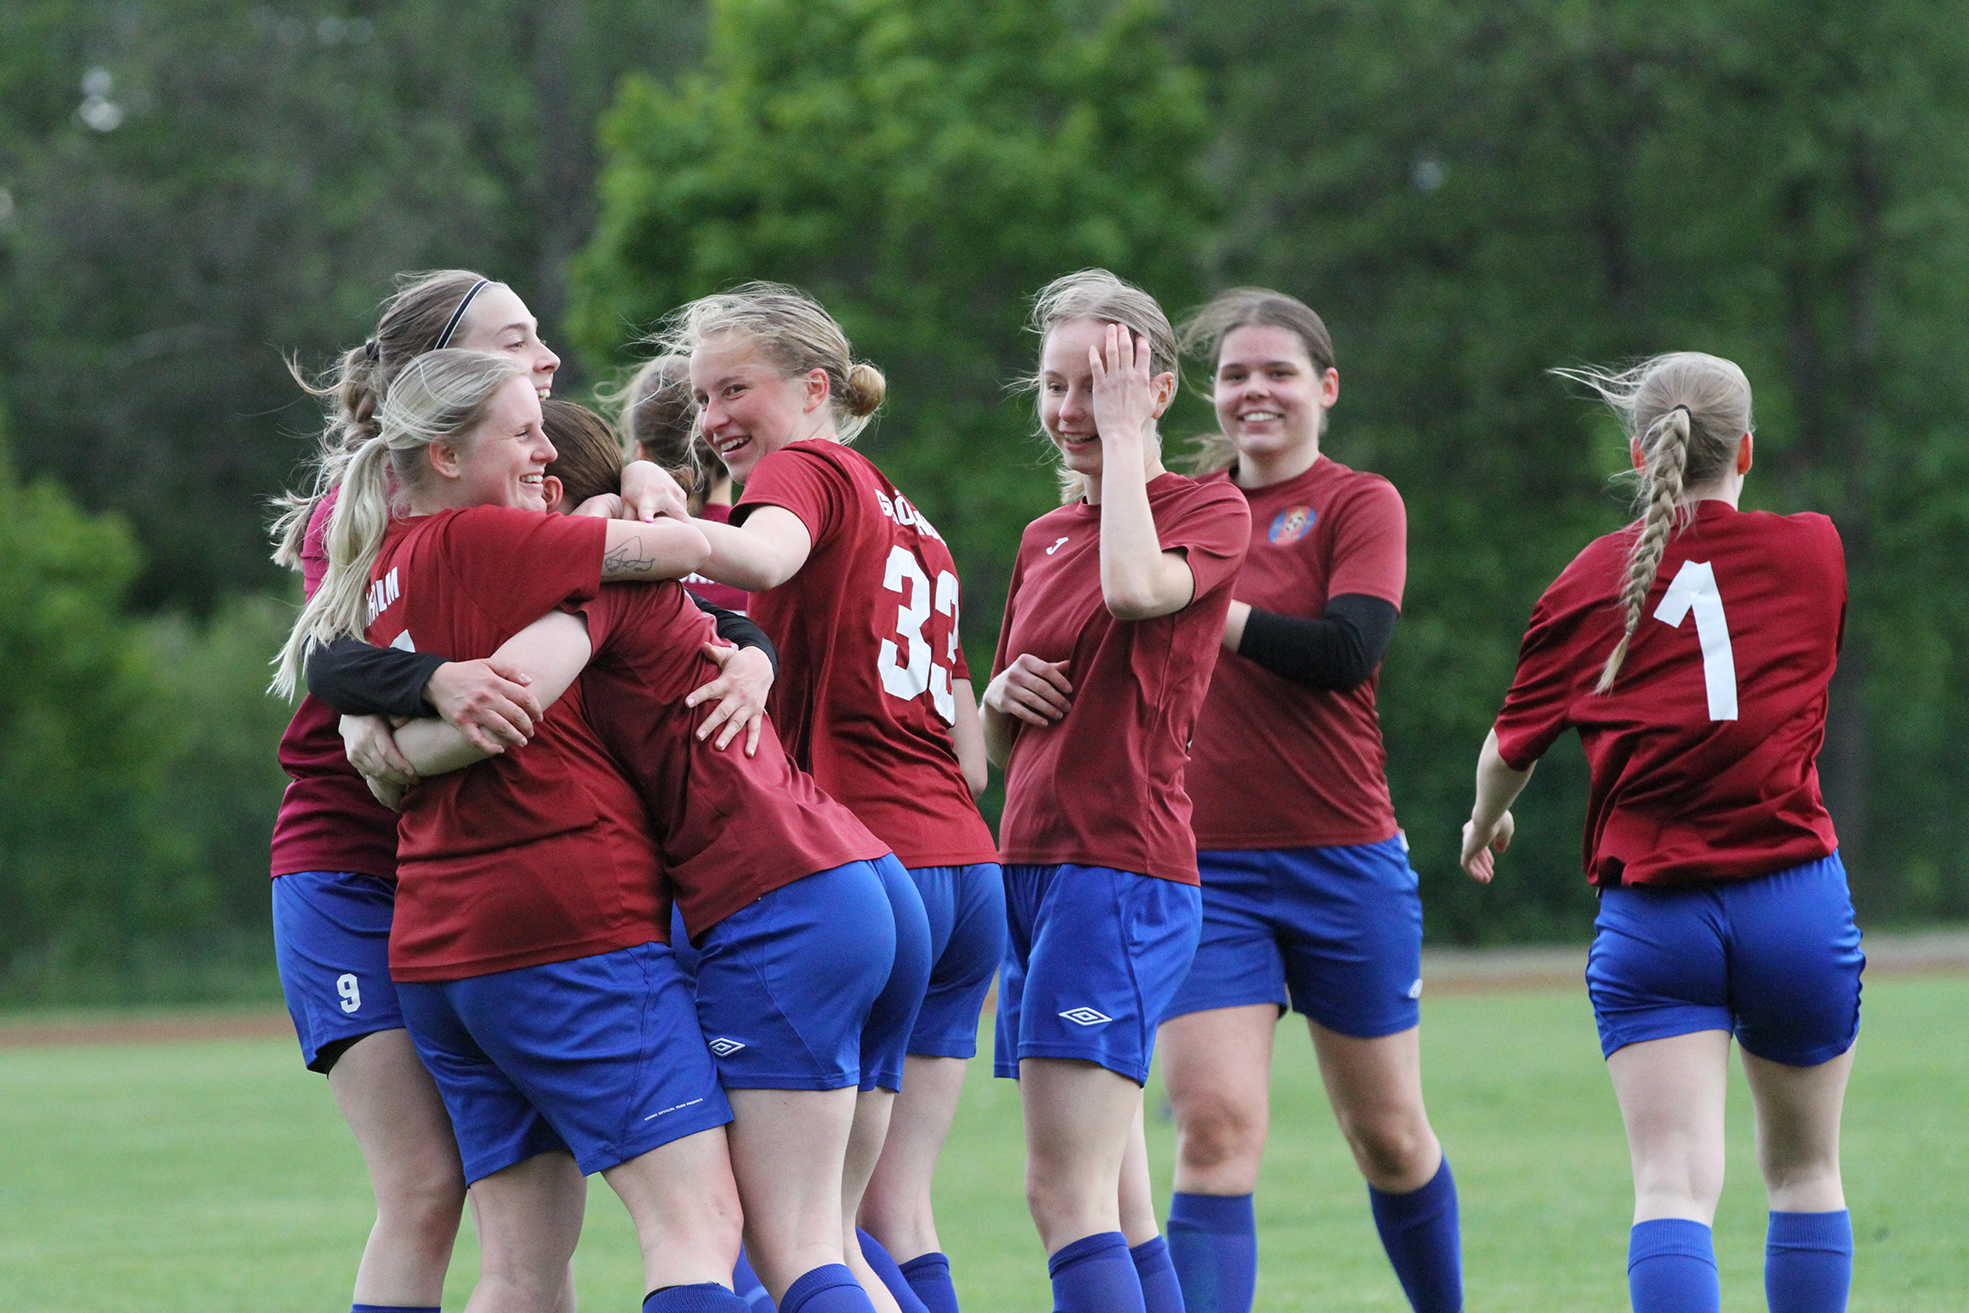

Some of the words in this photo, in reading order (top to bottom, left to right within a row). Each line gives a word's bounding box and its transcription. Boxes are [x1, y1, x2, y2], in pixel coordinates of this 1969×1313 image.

[877, 545, 959, 727] 33
[1653, 559, 1738, 721] 1
[336, 973, 361, 1013] 9
